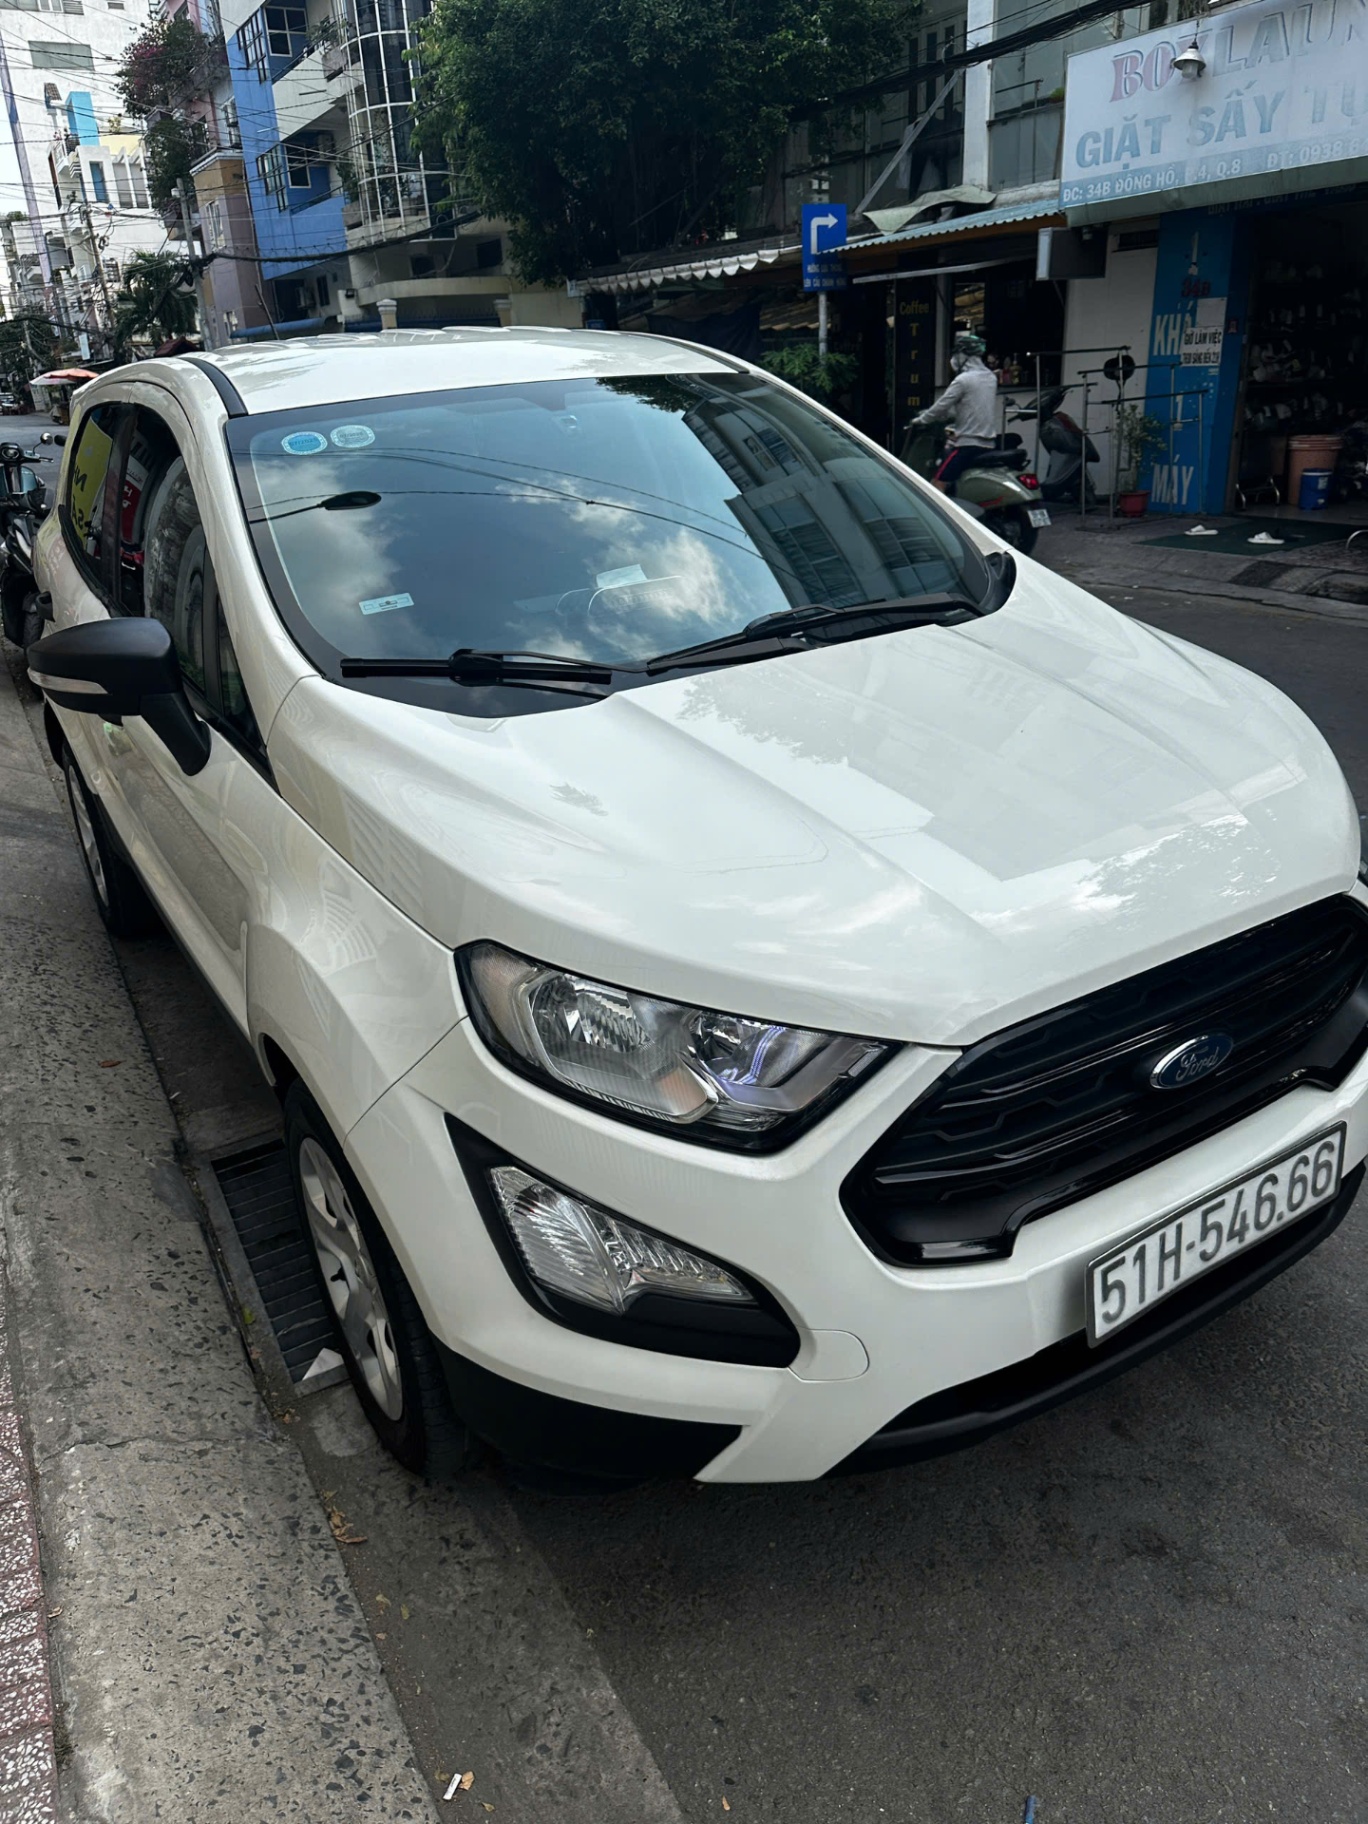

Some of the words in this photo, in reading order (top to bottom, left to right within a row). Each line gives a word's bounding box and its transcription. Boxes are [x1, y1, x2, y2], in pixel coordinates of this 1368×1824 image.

[1075, 114, 1171, 170] GIẶT
[1187, 80, 1287, 147] SẤY
[1063, 187, 1083, 202] ĐC:
[1087, 181, 1110, 198] 34B
[1217, 158, 1241, 178] Q.8
[1267, 149, 1294, 168] ĐT:
[899, 299, 929, 316] Coffee
[1151, 453, 1194, 505] MÁY
[1175, 1045, 1220, 1082] Ford
[1101, 1140, 1335, 1325] 51H-546.66
